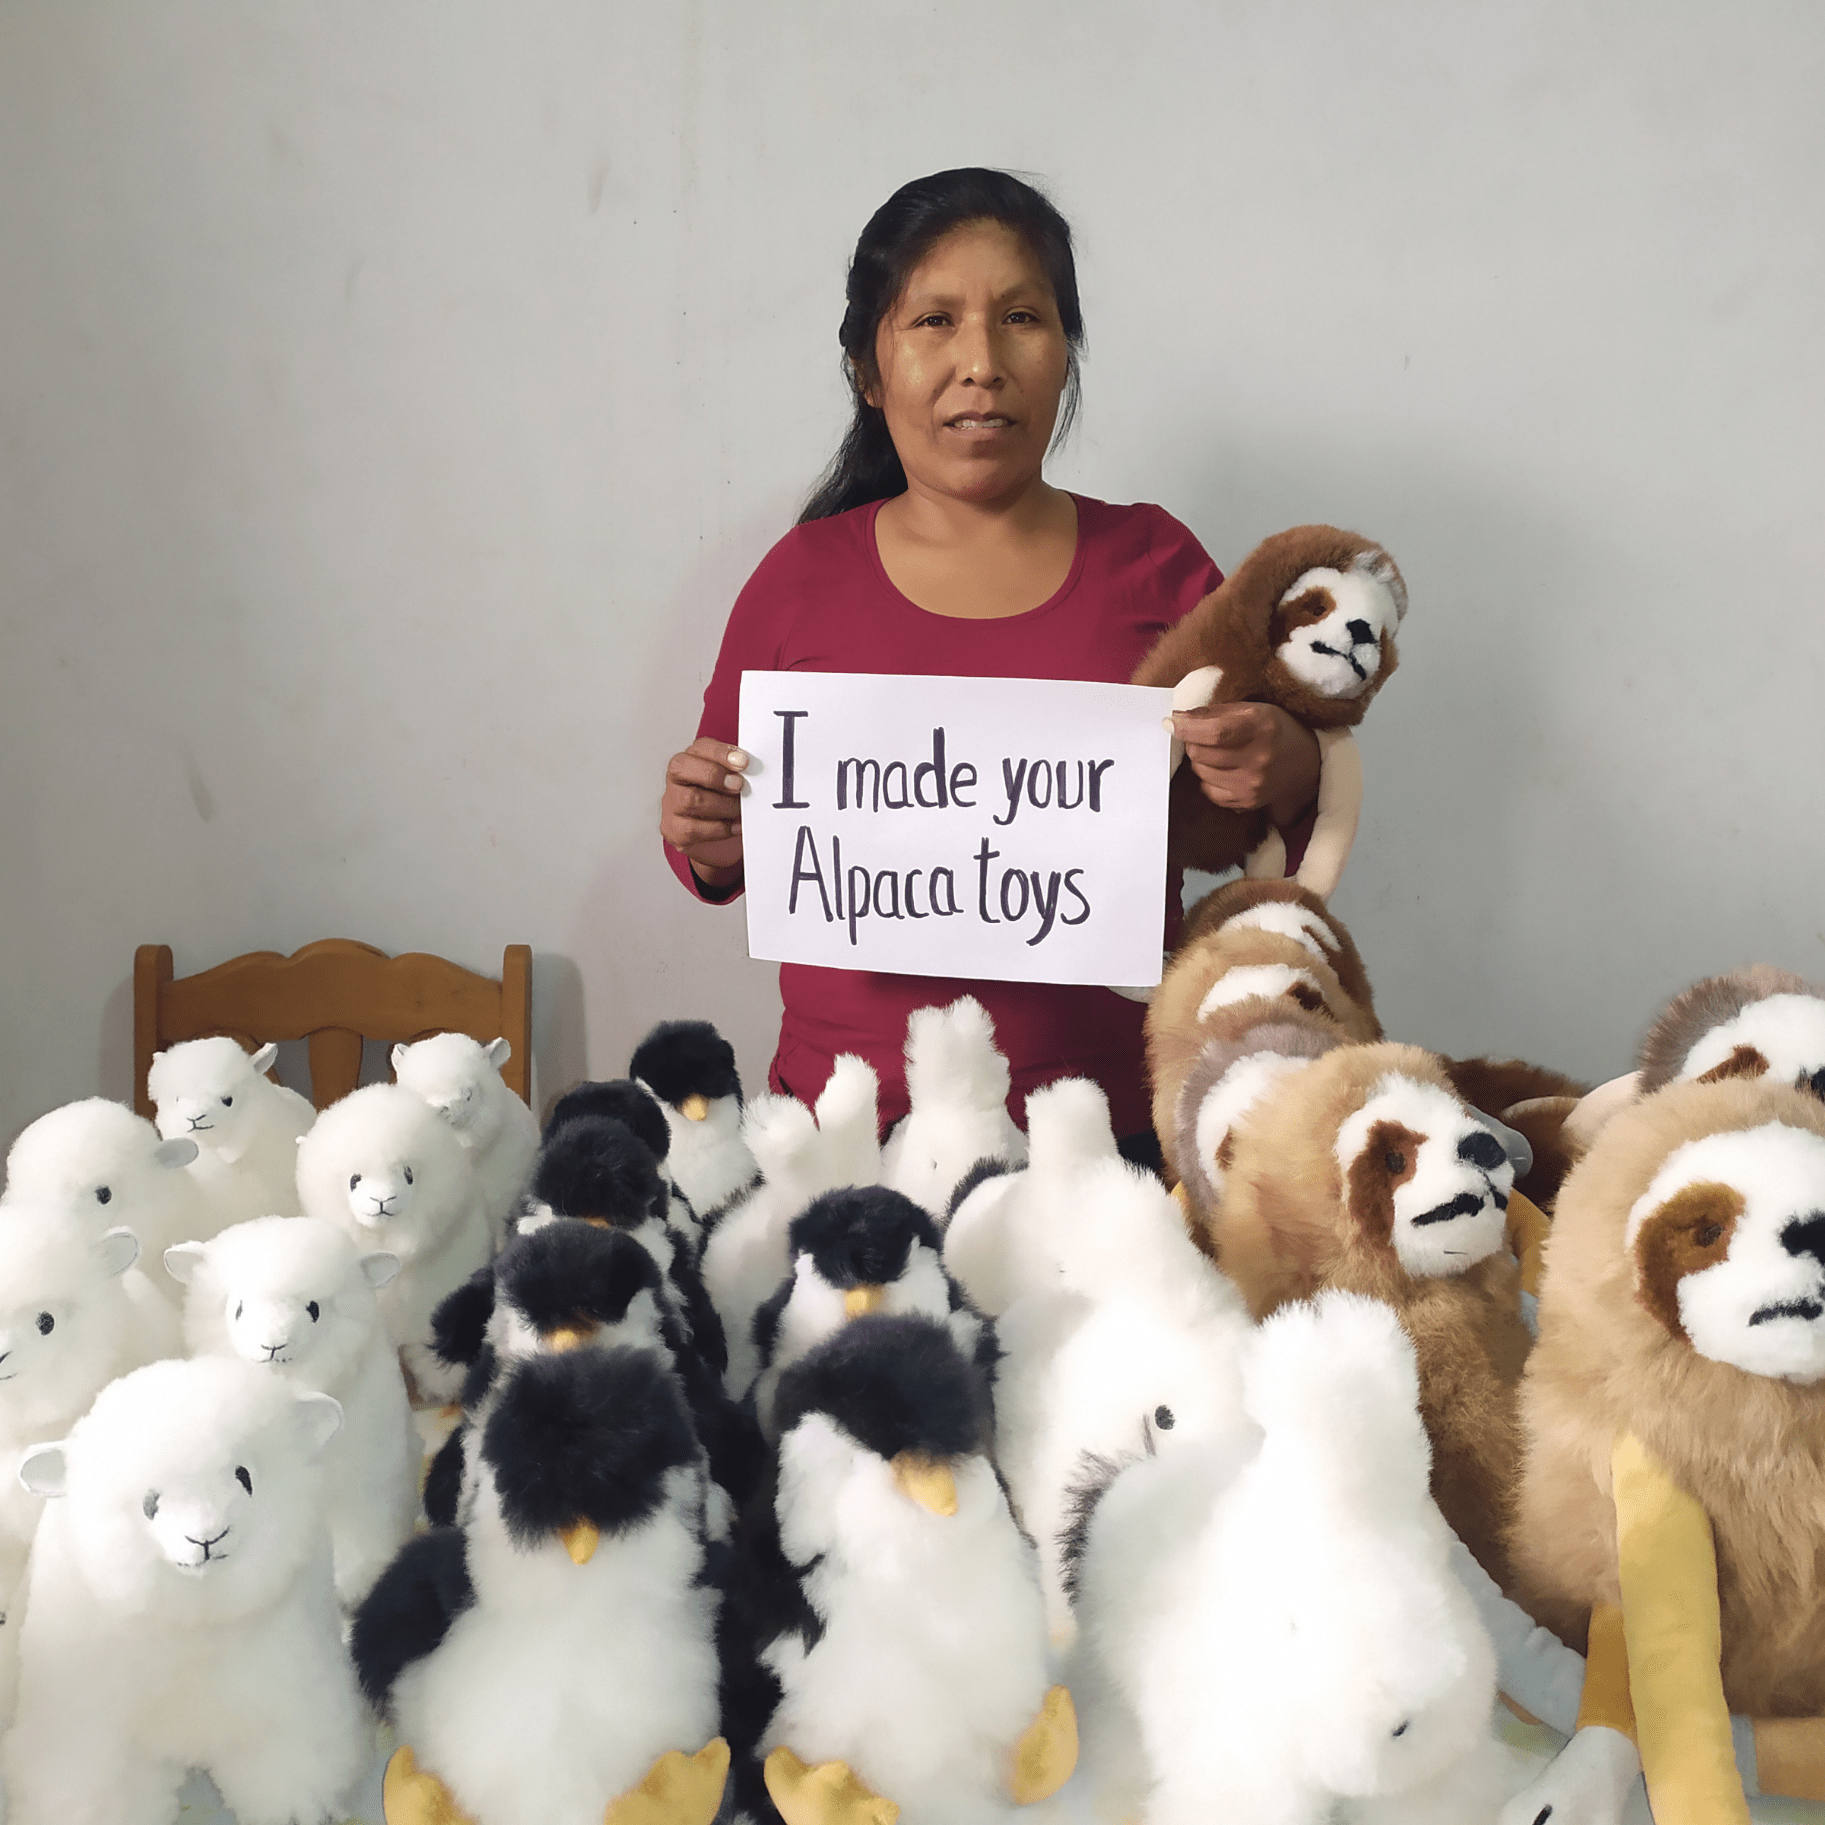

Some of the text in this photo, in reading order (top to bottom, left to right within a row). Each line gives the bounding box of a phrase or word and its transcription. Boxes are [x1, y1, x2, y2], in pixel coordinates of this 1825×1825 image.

[772, 710, 1115, 826] I made your
[788, 825, 1091, 947] Alpaca toys
